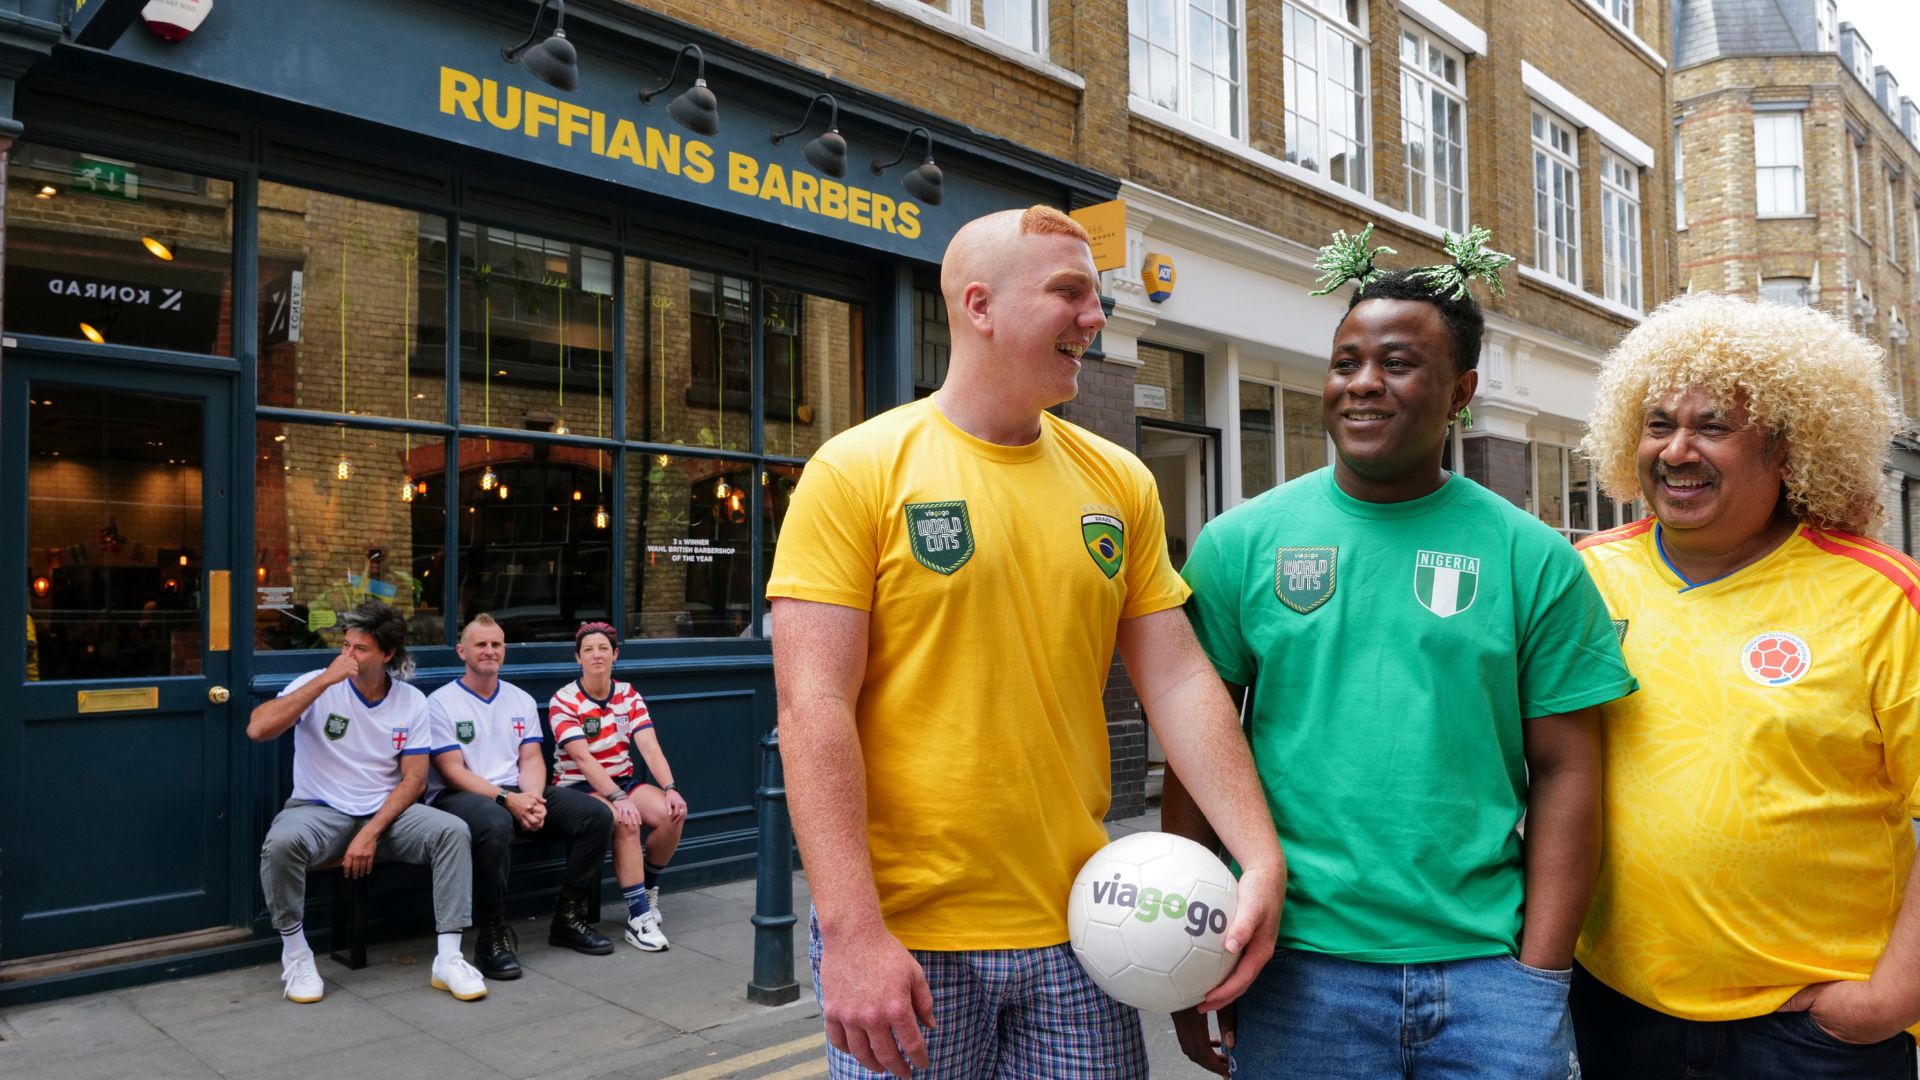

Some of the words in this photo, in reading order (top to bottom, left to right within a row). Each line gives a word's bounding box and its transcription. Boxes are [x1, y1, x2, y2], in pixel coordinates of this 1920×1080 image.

[440, 65, 715, 186] RUFFIANS
[728, 151, 921, 239] BARBERS
[1159, 267, 1171, 280] ADT
[916, 517, 963, 536] WORLD
[647, 545, 667, 553] WAHL
[684, 538, 710, 546] WINNER
[926, 533, 960, 553] CUTS
[1283, 559, 1328, 576] WORLD
[1420, 553, 1475, 572] NIGERIA
[1288, 574, 1321, 591] CUTS
[1092, 873, 1228, 937] viagogo
